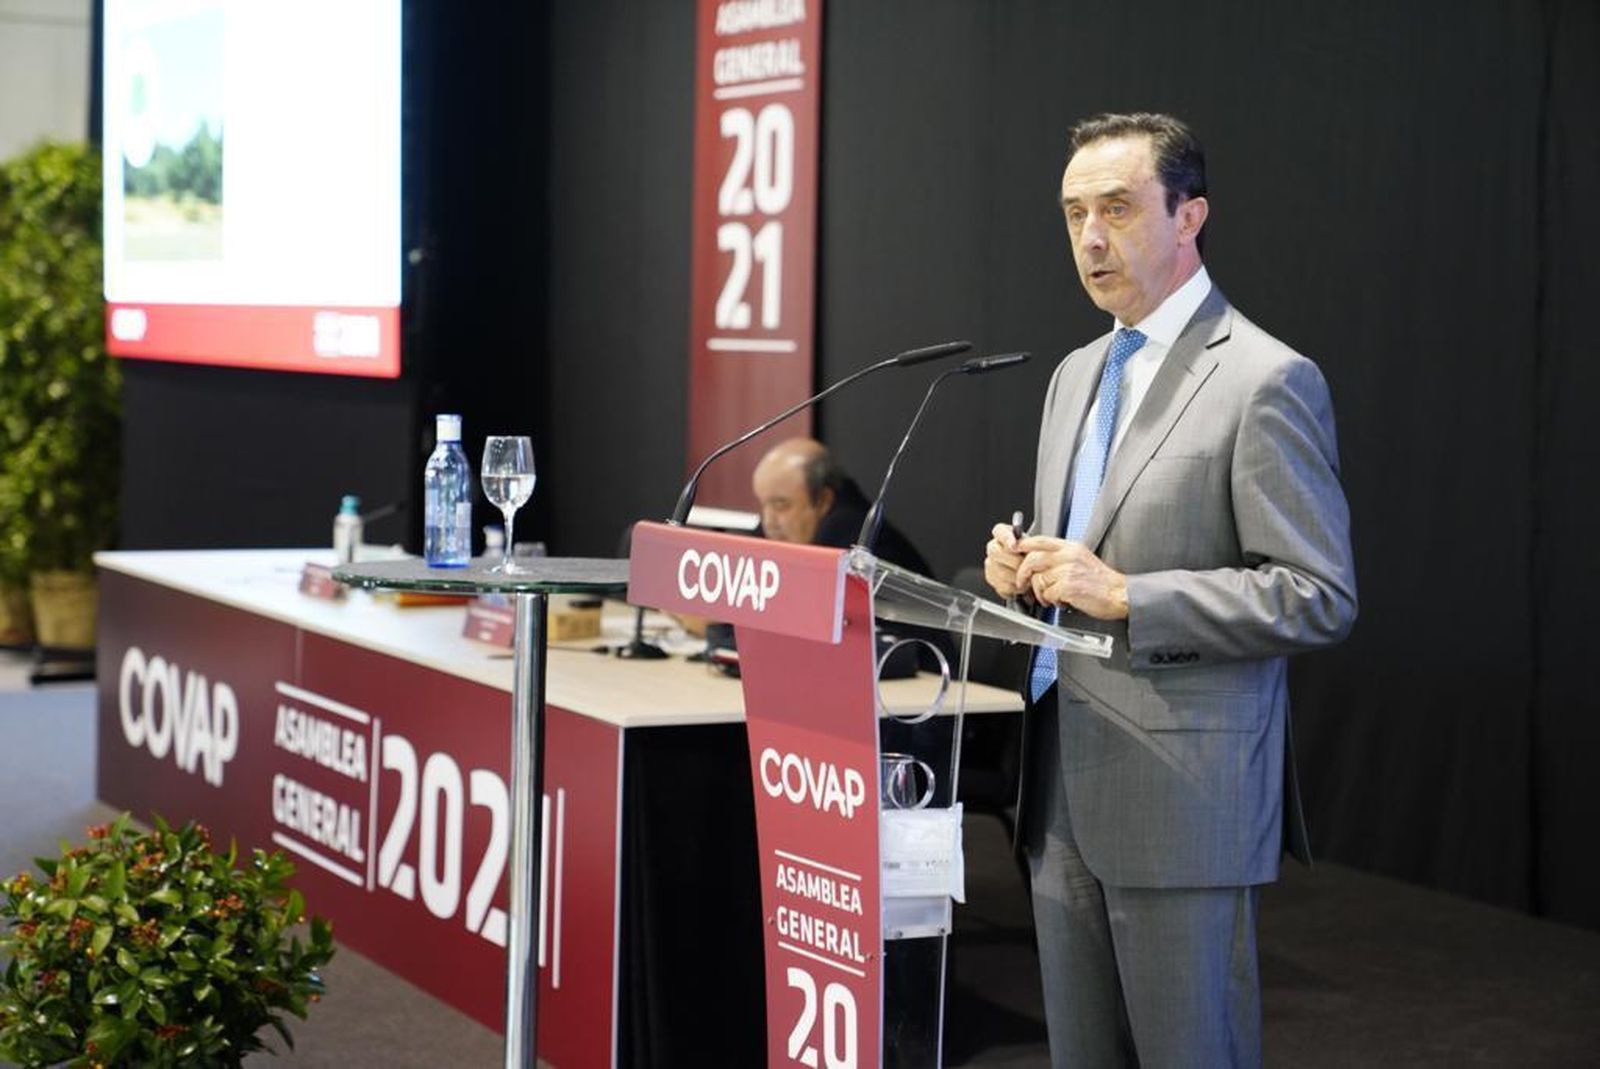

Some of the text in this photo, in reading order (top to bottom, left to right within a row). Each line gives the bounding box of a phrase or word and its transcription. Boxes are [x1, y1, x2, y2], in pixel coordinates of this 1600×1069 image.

[718, 103, 795, 216] 20
[715, 220, 783, 330] 21
[678, 549, 780, 612] COVAP
[119, 646, 239, 788] COVAP
[274, 704, 367, 782] ASAMBLEA
[272, 773, 365, 864] GENERAL
[760, 748, 865, 819] COVAP
[776, 864, 863, 916] ASAMBLEA
[776, 906, 866, 963] GENERAL
[786, 966, 858, 1069] 20
